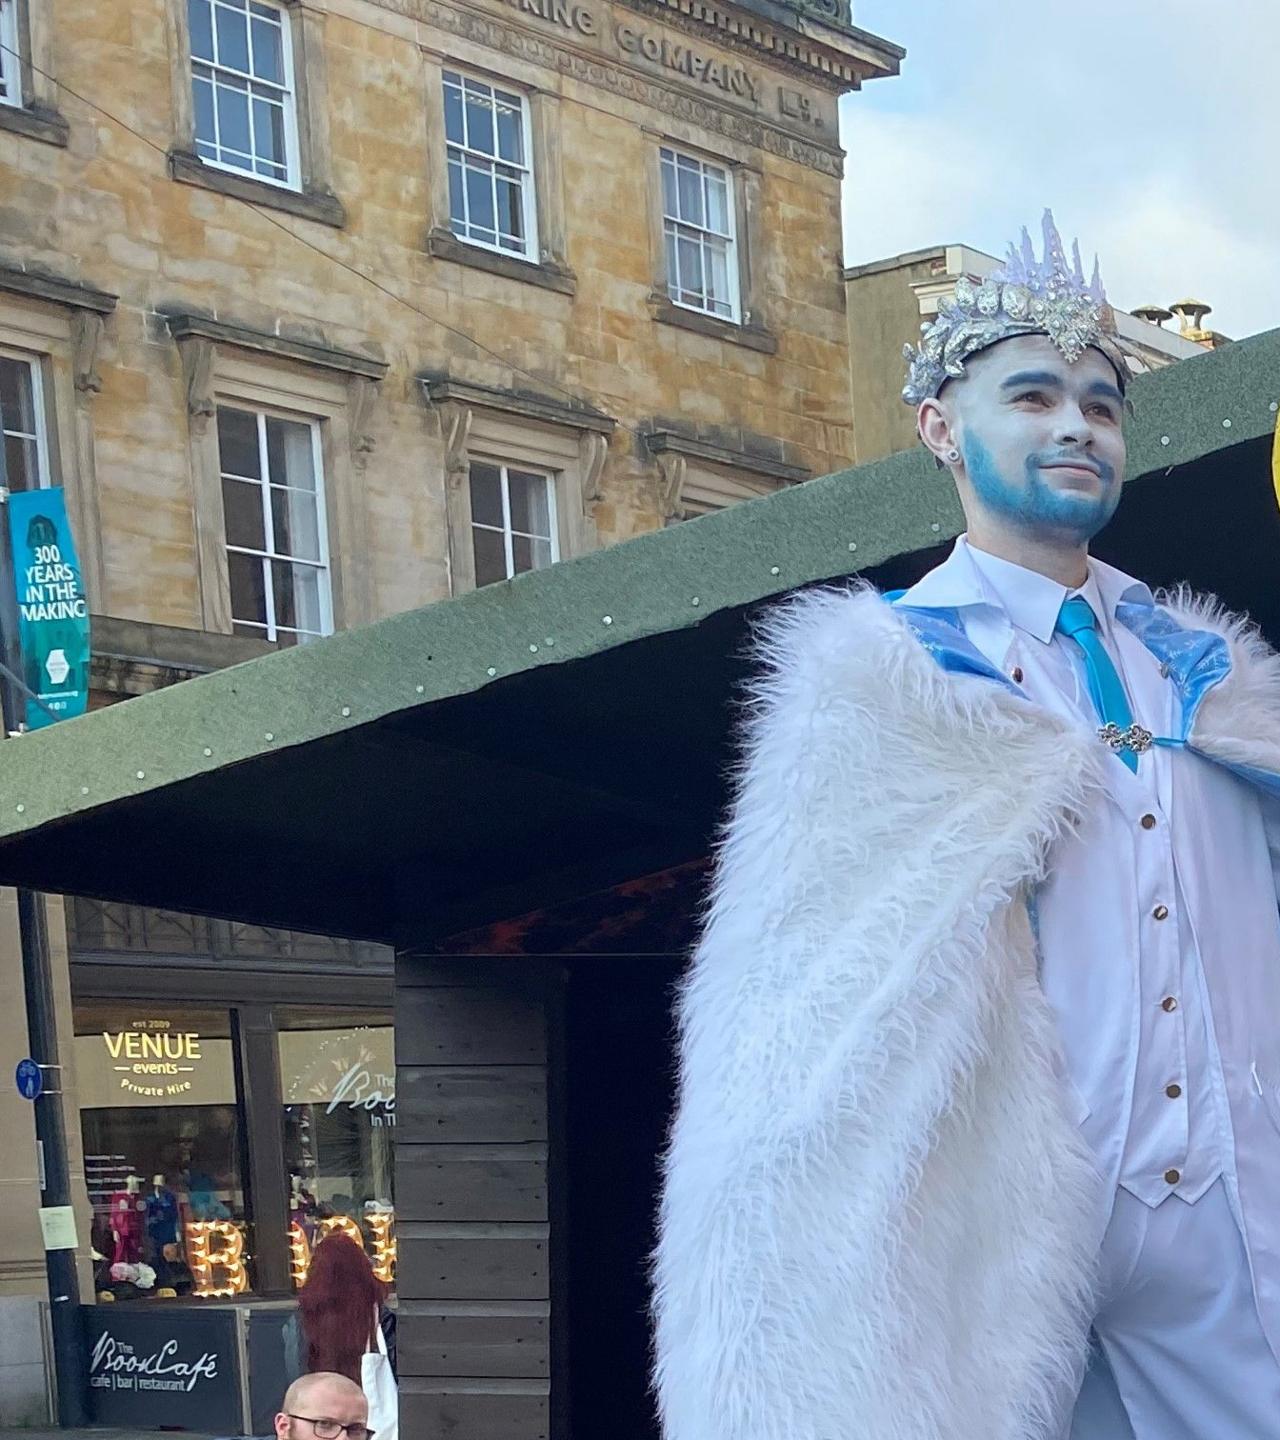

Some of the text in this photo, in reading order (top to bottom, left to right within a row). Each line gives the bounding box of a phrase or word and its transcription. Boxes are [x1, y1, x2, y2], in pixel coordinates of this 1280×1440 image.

[617, 22, 759, 102] COMPANY
[34, 545, 61, 565] 300
[25, 562, 74, 584] YEARS
[26, 581, 78, 602] IN THE
[20, 600, 86, 622] MAKING
[103, 1031, 202, 1059] VENUE
[133, 1062, 178, 1075] events
[120, 1078, 192, 1097] Private Hire
[116, 1341, 134, 1354] The
[139, 1377, 185, 1391] restaurant
